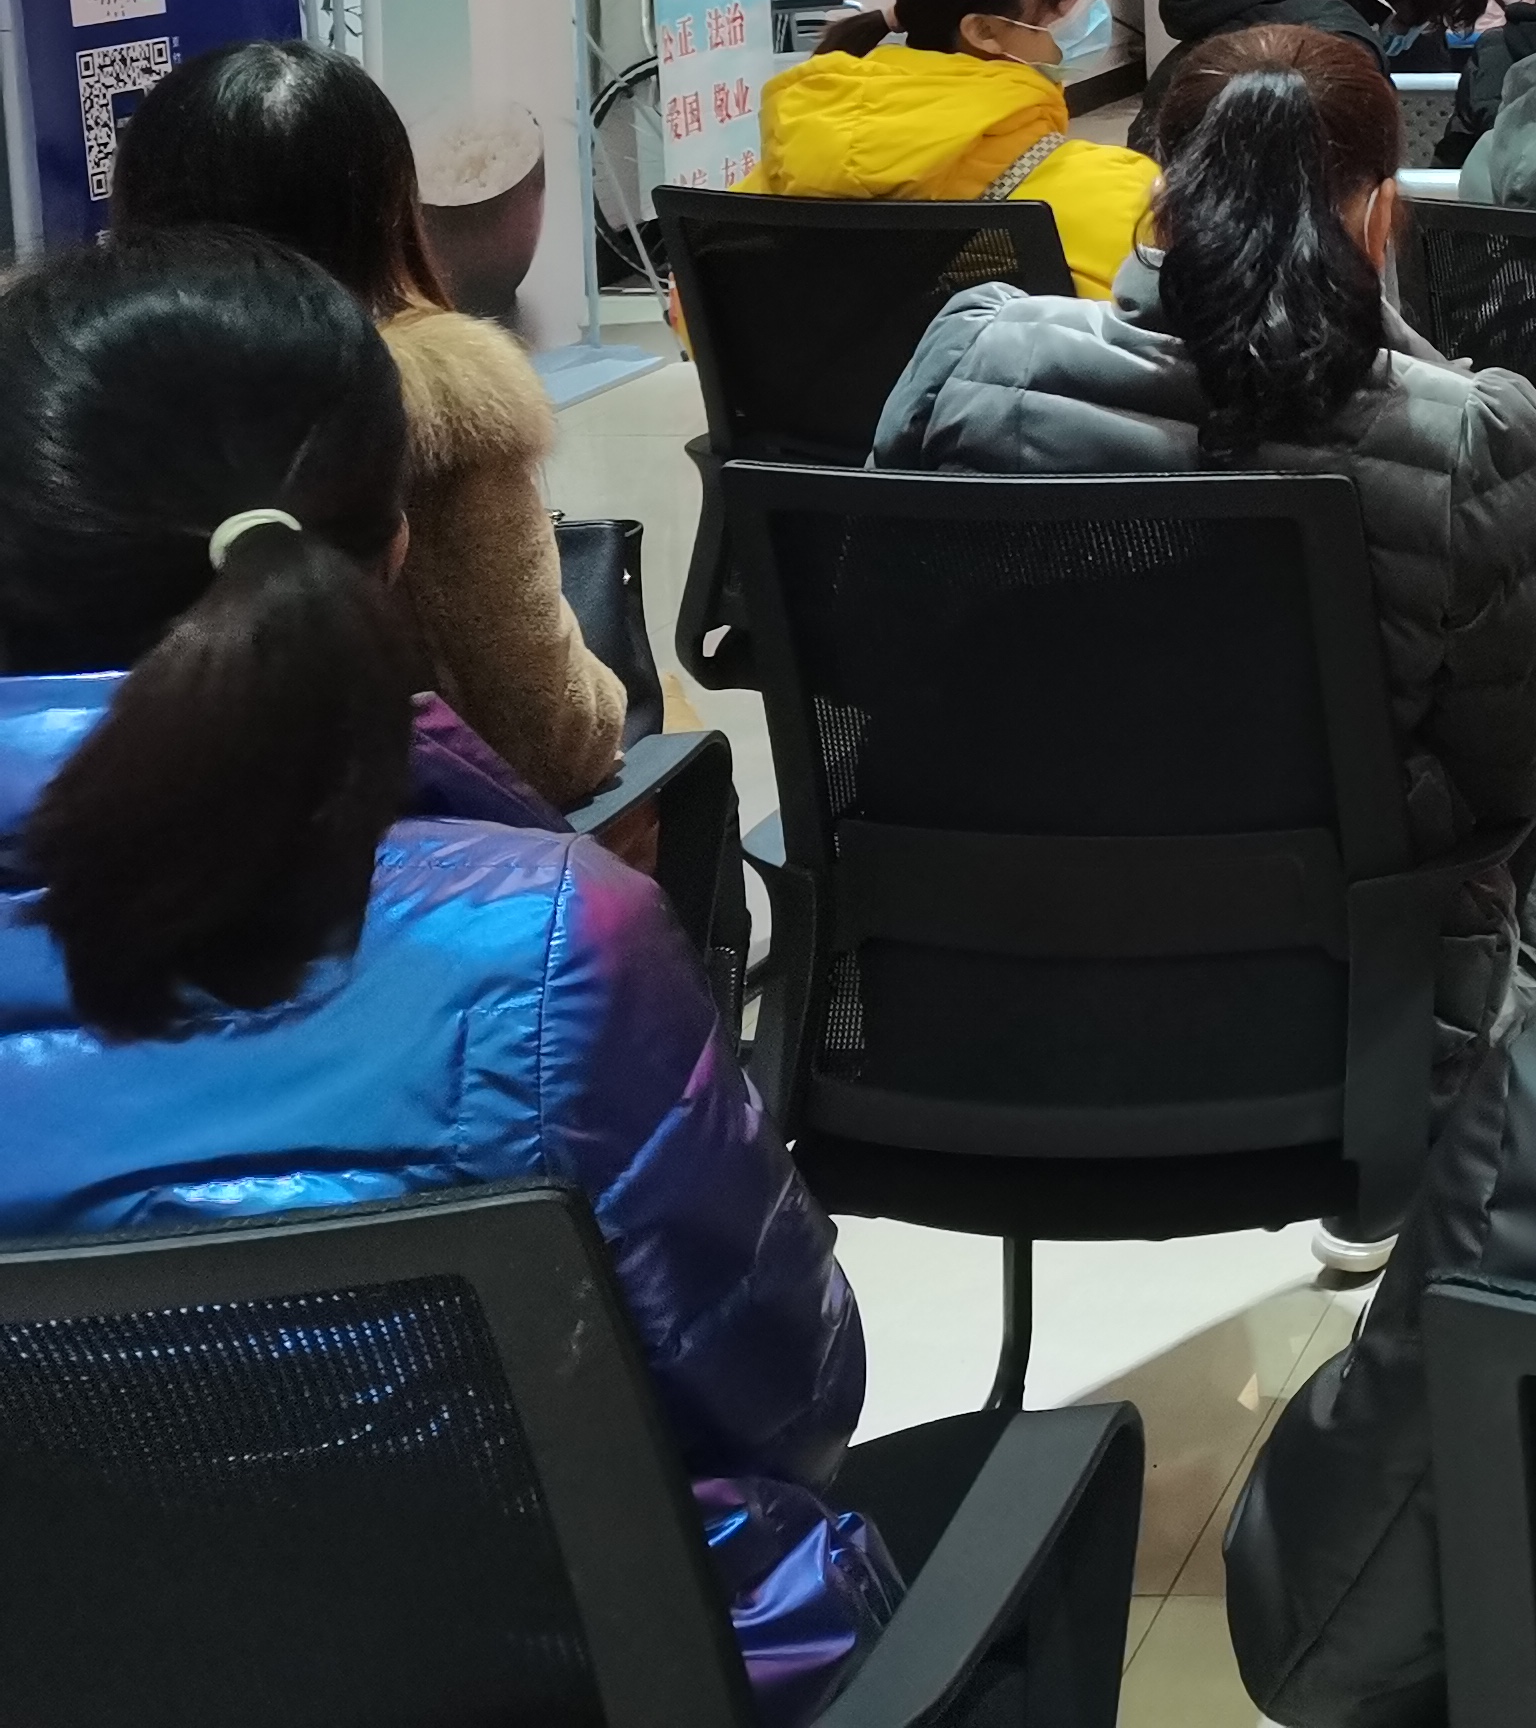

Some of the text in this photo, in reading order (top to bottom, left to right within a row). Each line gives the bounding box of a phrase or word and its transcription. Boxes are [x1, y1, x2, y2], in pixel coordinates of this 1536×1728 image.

[660, 17, 697, 63] 公正
[706, 1, 746, 51] 法治
[665, 90, 702, 140] 爱国
[712, 77, 754, 125] 敬业
